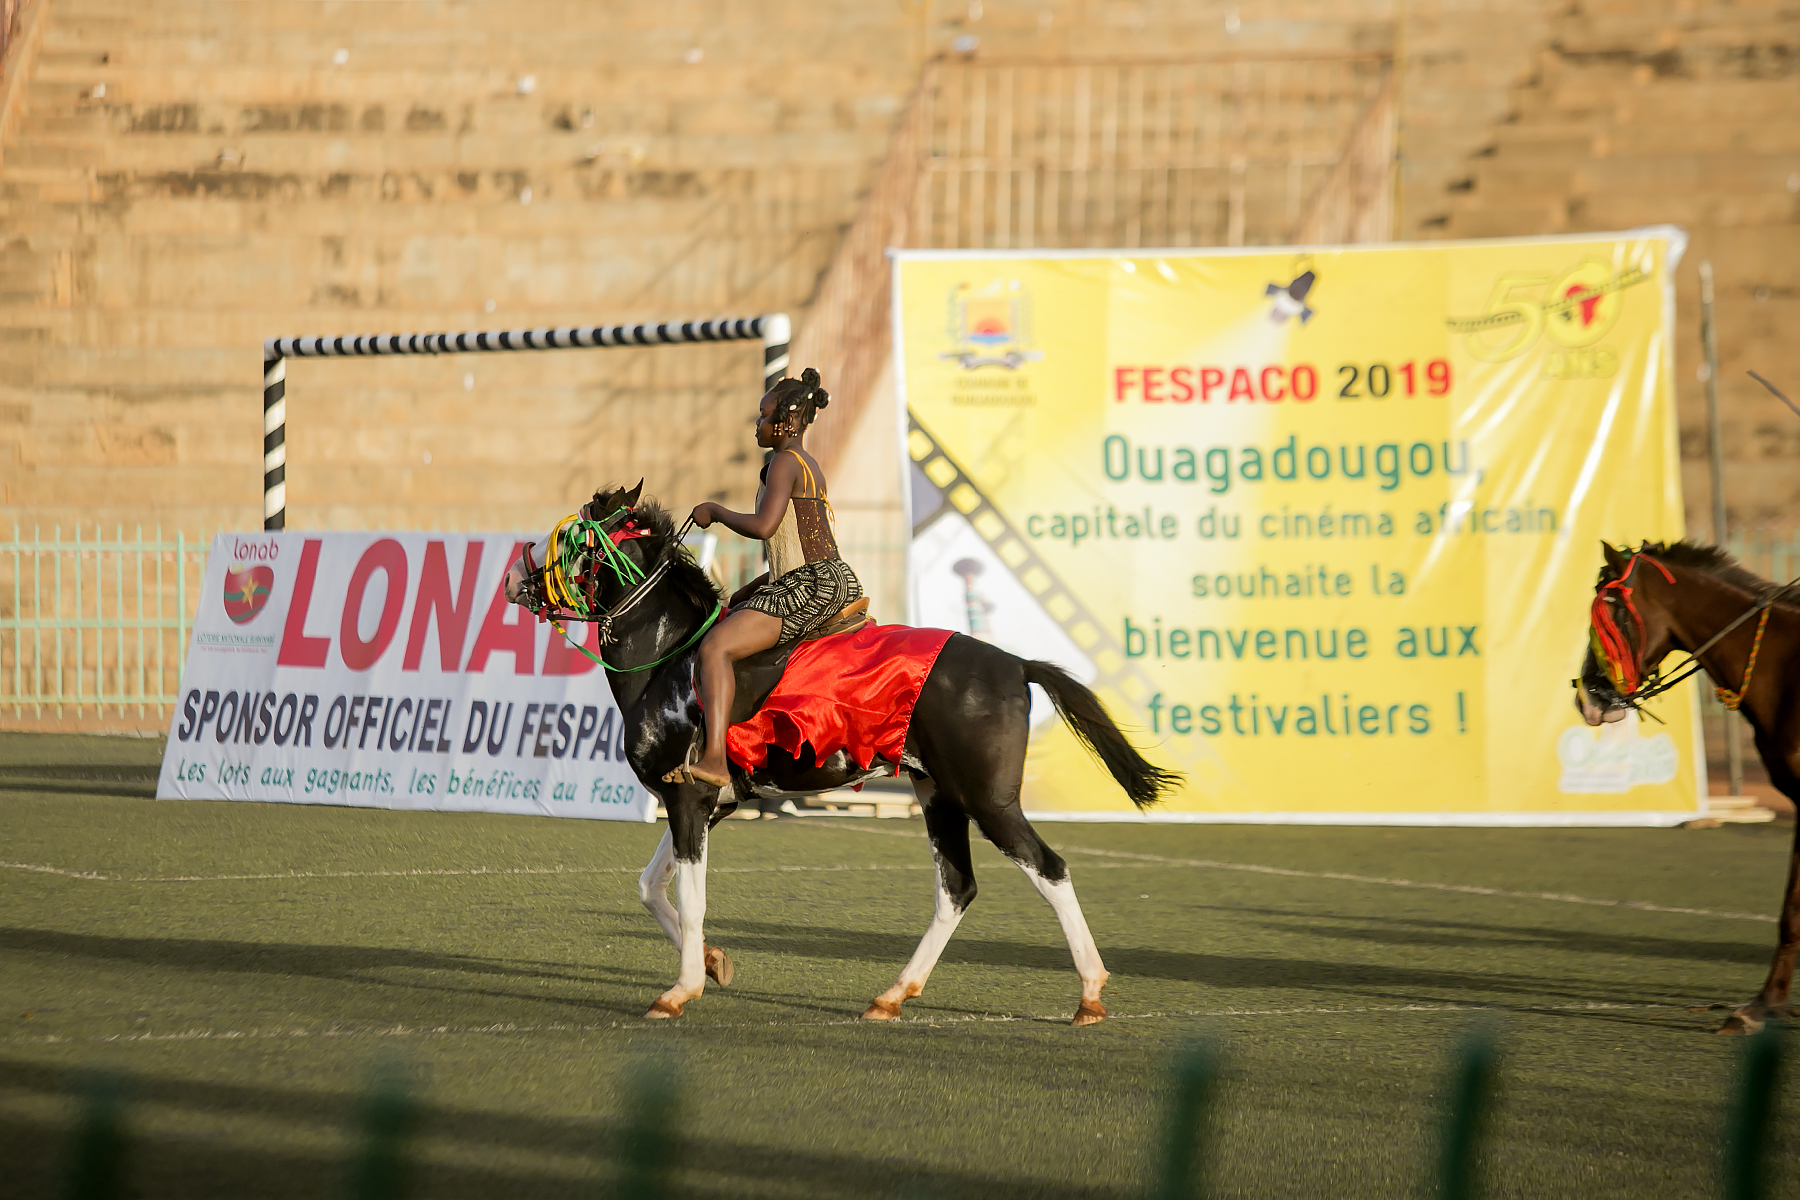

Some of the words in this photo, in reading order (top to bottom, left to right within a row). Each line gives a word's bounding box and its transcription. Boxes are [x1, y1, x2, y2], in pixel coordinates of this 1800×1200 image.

[1114, 366, 1316, 403] FESPACO
[1339, 362, 1450, 398] 2019
[1104, 435, 1483, 492] Ouagadougou,
[1027, 506, 1178, 546] capitale
[1199, 506, 1239, 538] du
[1260, 504, 1393, 538] cinéma
[234, 536, 279, 560] lonab
[1192, 565, 1351, 597] souhaite
[1372, 564, 1405, 597] la
[1125, 617, 1368, 659] bienvenue
[1398, 625, 1480, 657] aux
[178, 689, 319, 748] SPONSOR
[323, 694, 453, 753] OFFICIEL
[462, 699, 515, 758] DU
[1148, 693, 1430, 735] festivaliers
[1457, 691, 1467, 733] !
[177, 758, 206, 782] Les
[217, 757, 250, 786] lots
[260, 767, 295, 788] aux
[305, 767, 395, 796] gagnants,
[409, 767, 437, 795] les
[448, 767, 541, 800] bénéfices
[553, 781, 577, 802] au
